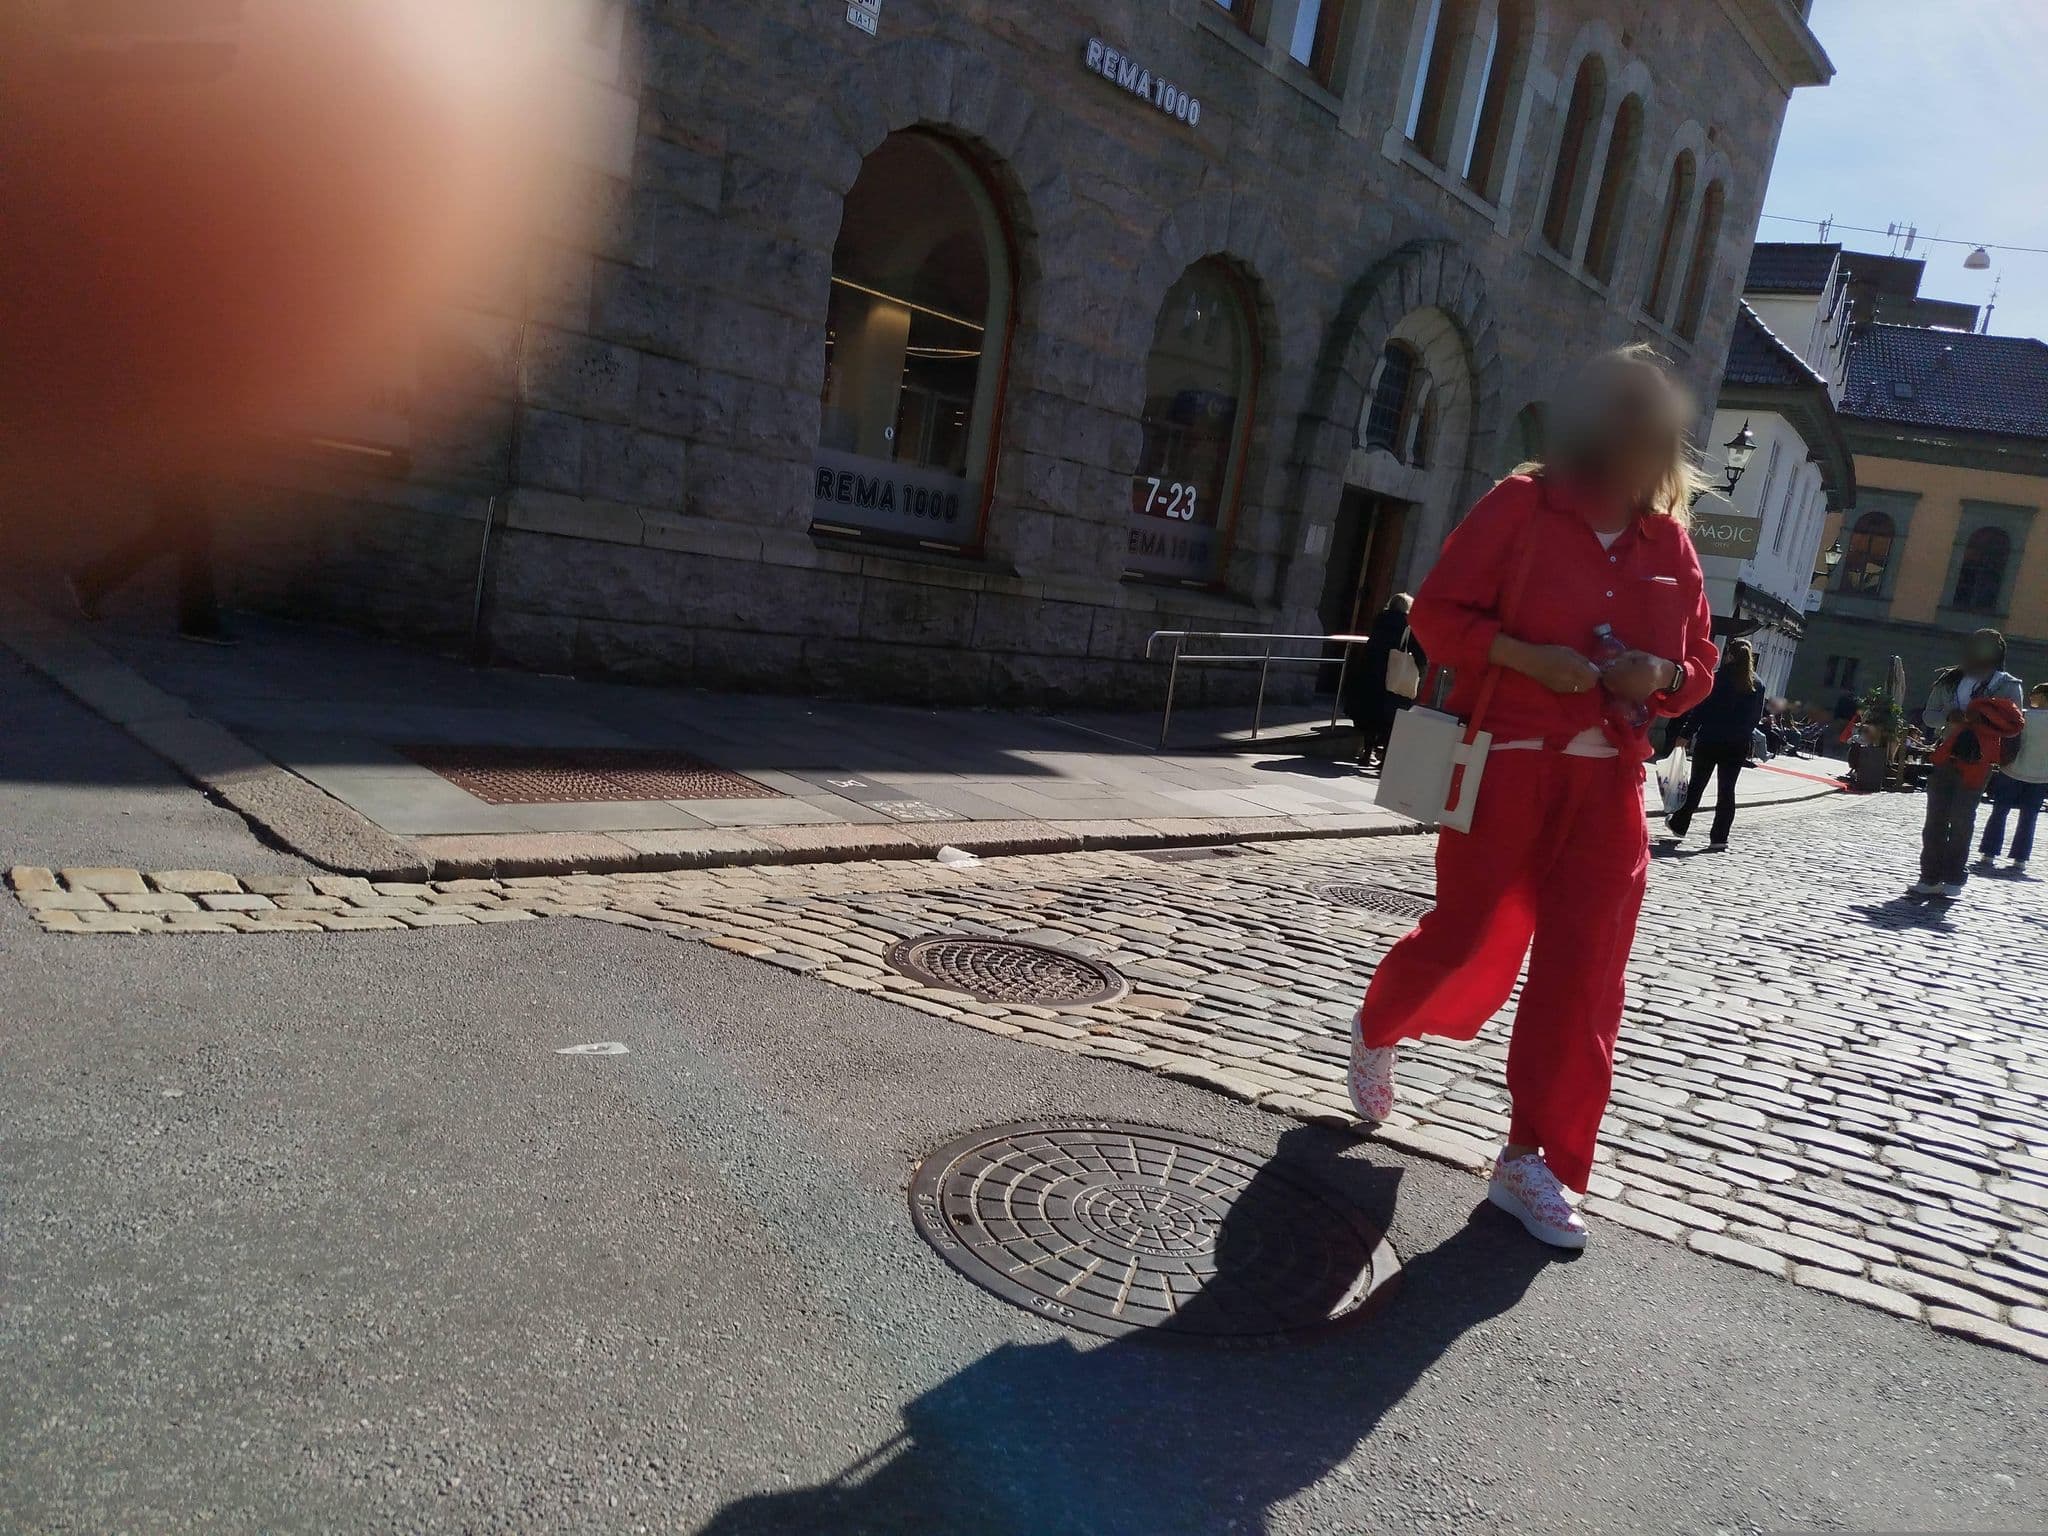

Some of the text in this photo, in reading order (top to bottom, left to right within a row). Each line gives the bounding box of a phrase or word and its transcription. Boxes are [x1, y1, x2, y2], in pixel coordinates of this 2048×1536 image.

[1086, 37, 1201, 128] REMA 1000
[815, 464, 959, 523] REMA 1000
[1145, 476, 1197, 521] 7-23
[1127, 528, 1167, 560] EMA
